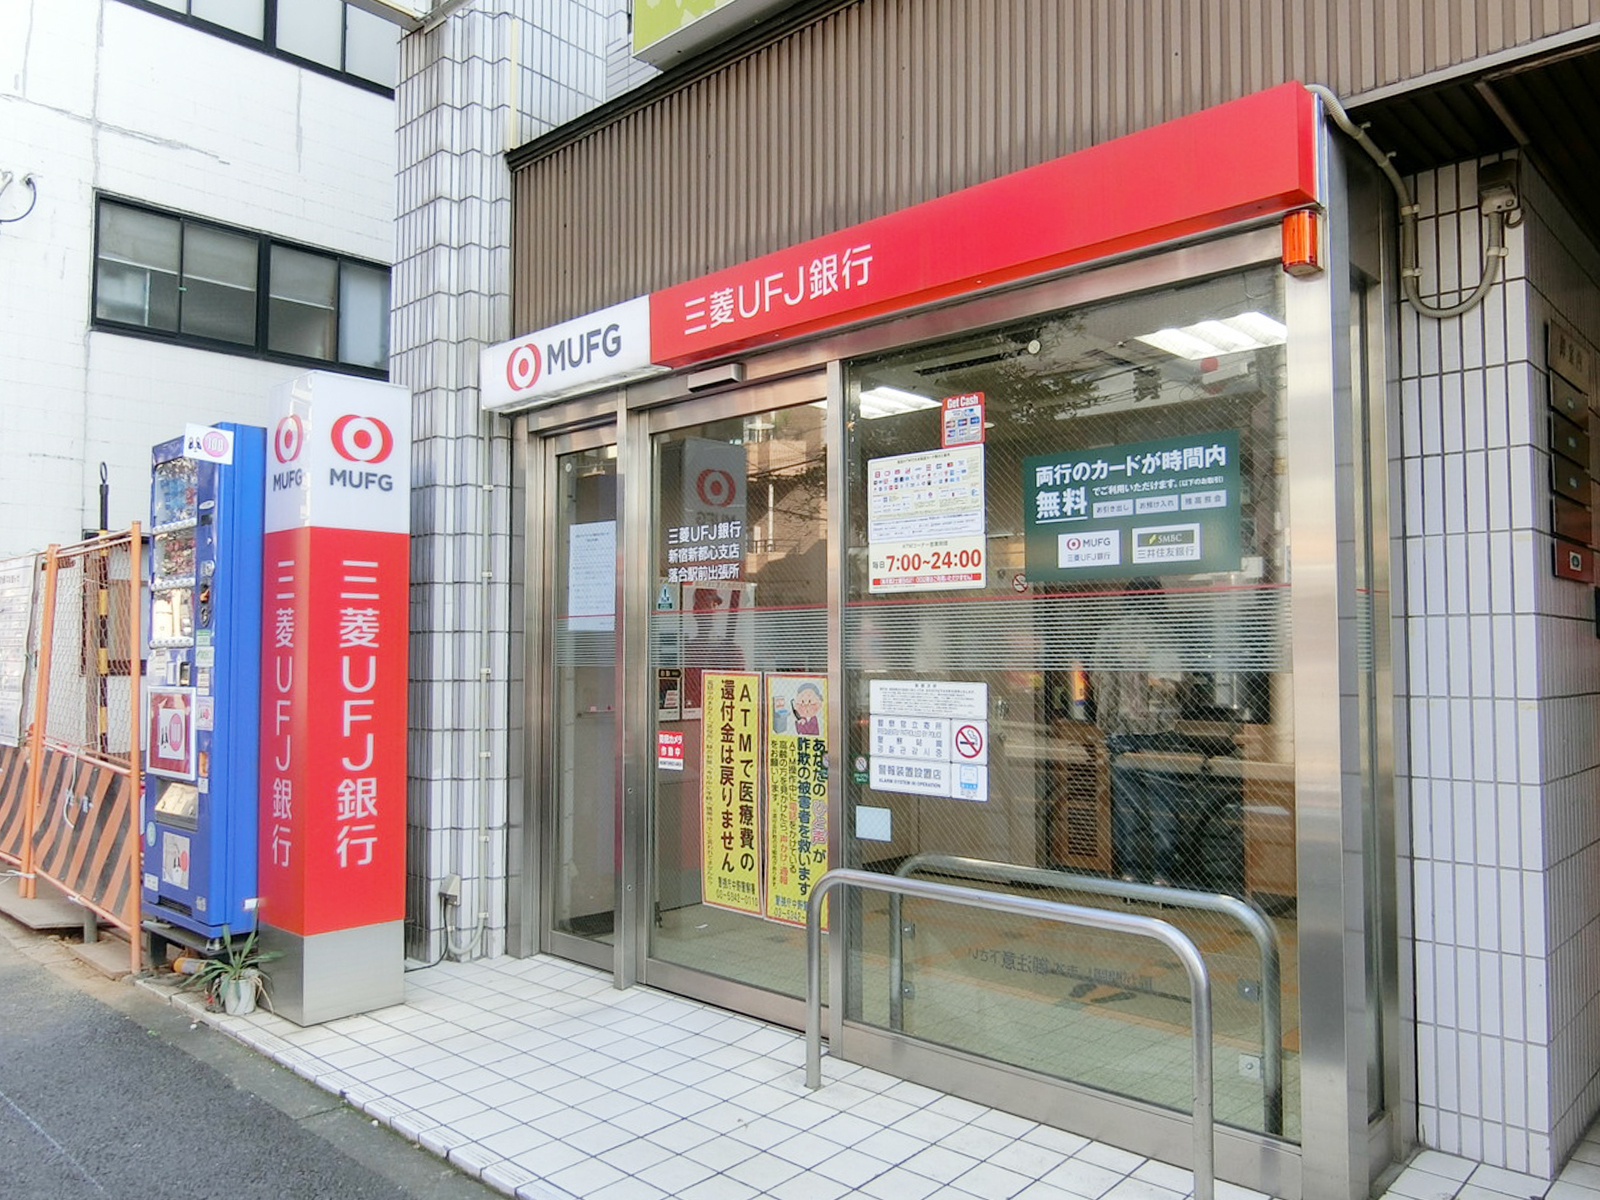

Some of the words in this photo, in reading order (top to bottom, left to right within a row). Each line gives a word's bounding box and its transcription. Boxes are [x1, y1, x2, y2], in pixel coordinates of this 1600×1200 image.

[684, 243, 873, 336] 三菱UFJ銀行
[546, 323, 622, 375] MUFG
[947, 397, 959, 409] Get
[960, 394, 978, 407] Cash
[1035, 444, 1226, 487] 両行のカードが時間内
[273, 468, 303, 492] MUFG
[330, 468, 393, 492] MUFG
[1035, 486, 1088, 519] 無料
[1096, 504, 1130, 514] お引き出し
[668, 521, 741, 545] 三菱UFJ銀行
[1083, 537, 1111, 547] MUFG
[1157, 534, 1182, 544] SMBC
[668, 543, 740, 563] 新宿新都心支店
[1067, 552, 1111, 562] 三菱UFJ銀行
[1137, 546, 1194, 559] 三井住友銀行
[668, 563, 740, 583] 落合駅前出張所
[272, 560, 295, 868] 三菱UFJ銀行
[336, 560, 380, 868] 三菱UFJ銀行
[720, 679, 735, 873] 還付金は戻りません
[739, 683, 754, 872] ATMで医療費の
[797, 737, 811, 895] 詐欺の被害者を救います
